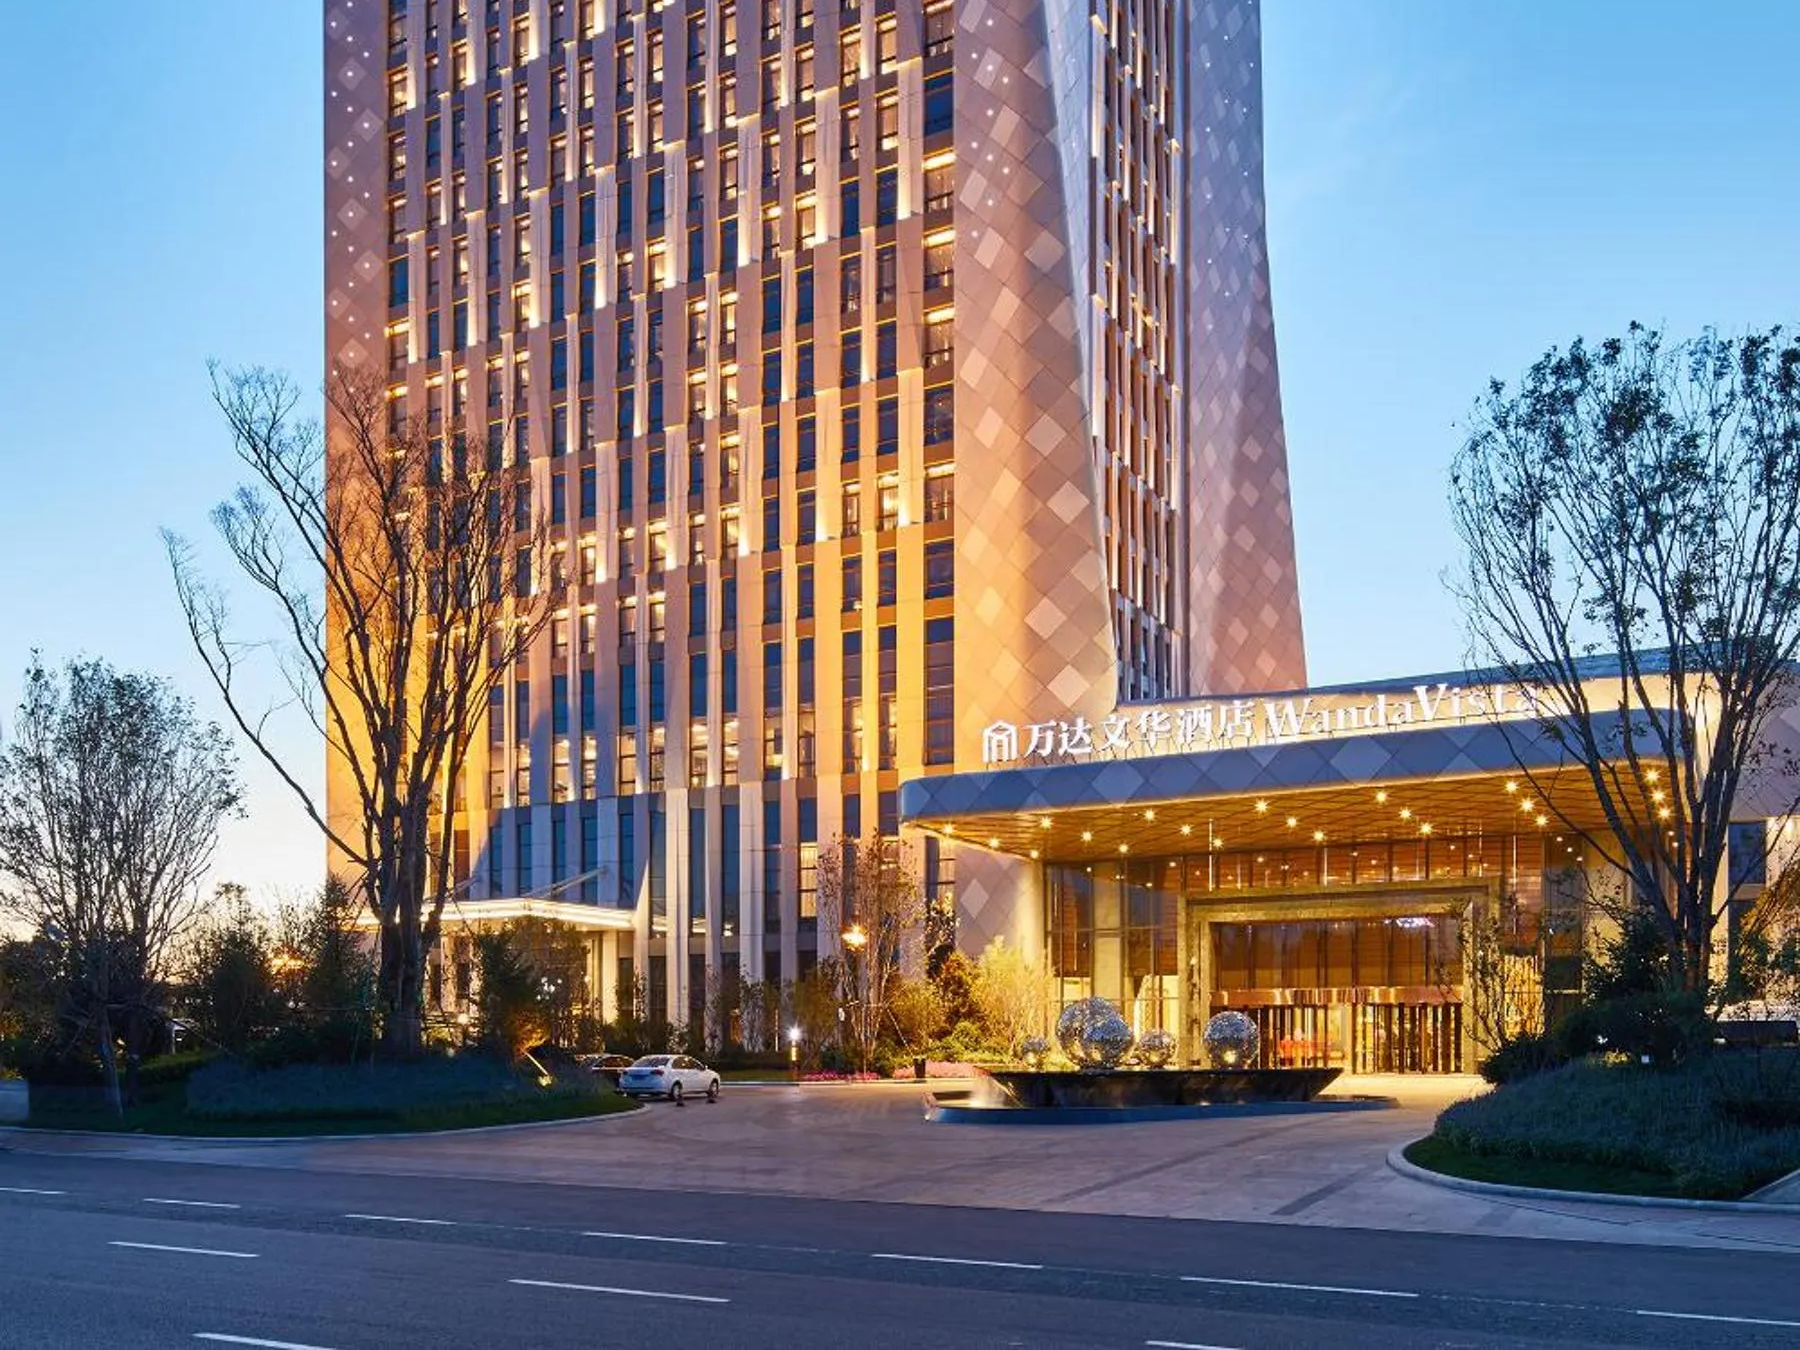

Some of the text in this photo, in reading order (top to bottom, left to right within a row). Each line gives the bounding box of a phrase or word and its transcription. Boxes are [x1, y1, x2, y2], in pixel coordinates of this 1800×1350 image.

[1023, 700, 1255, 758] 万达文华酒店
